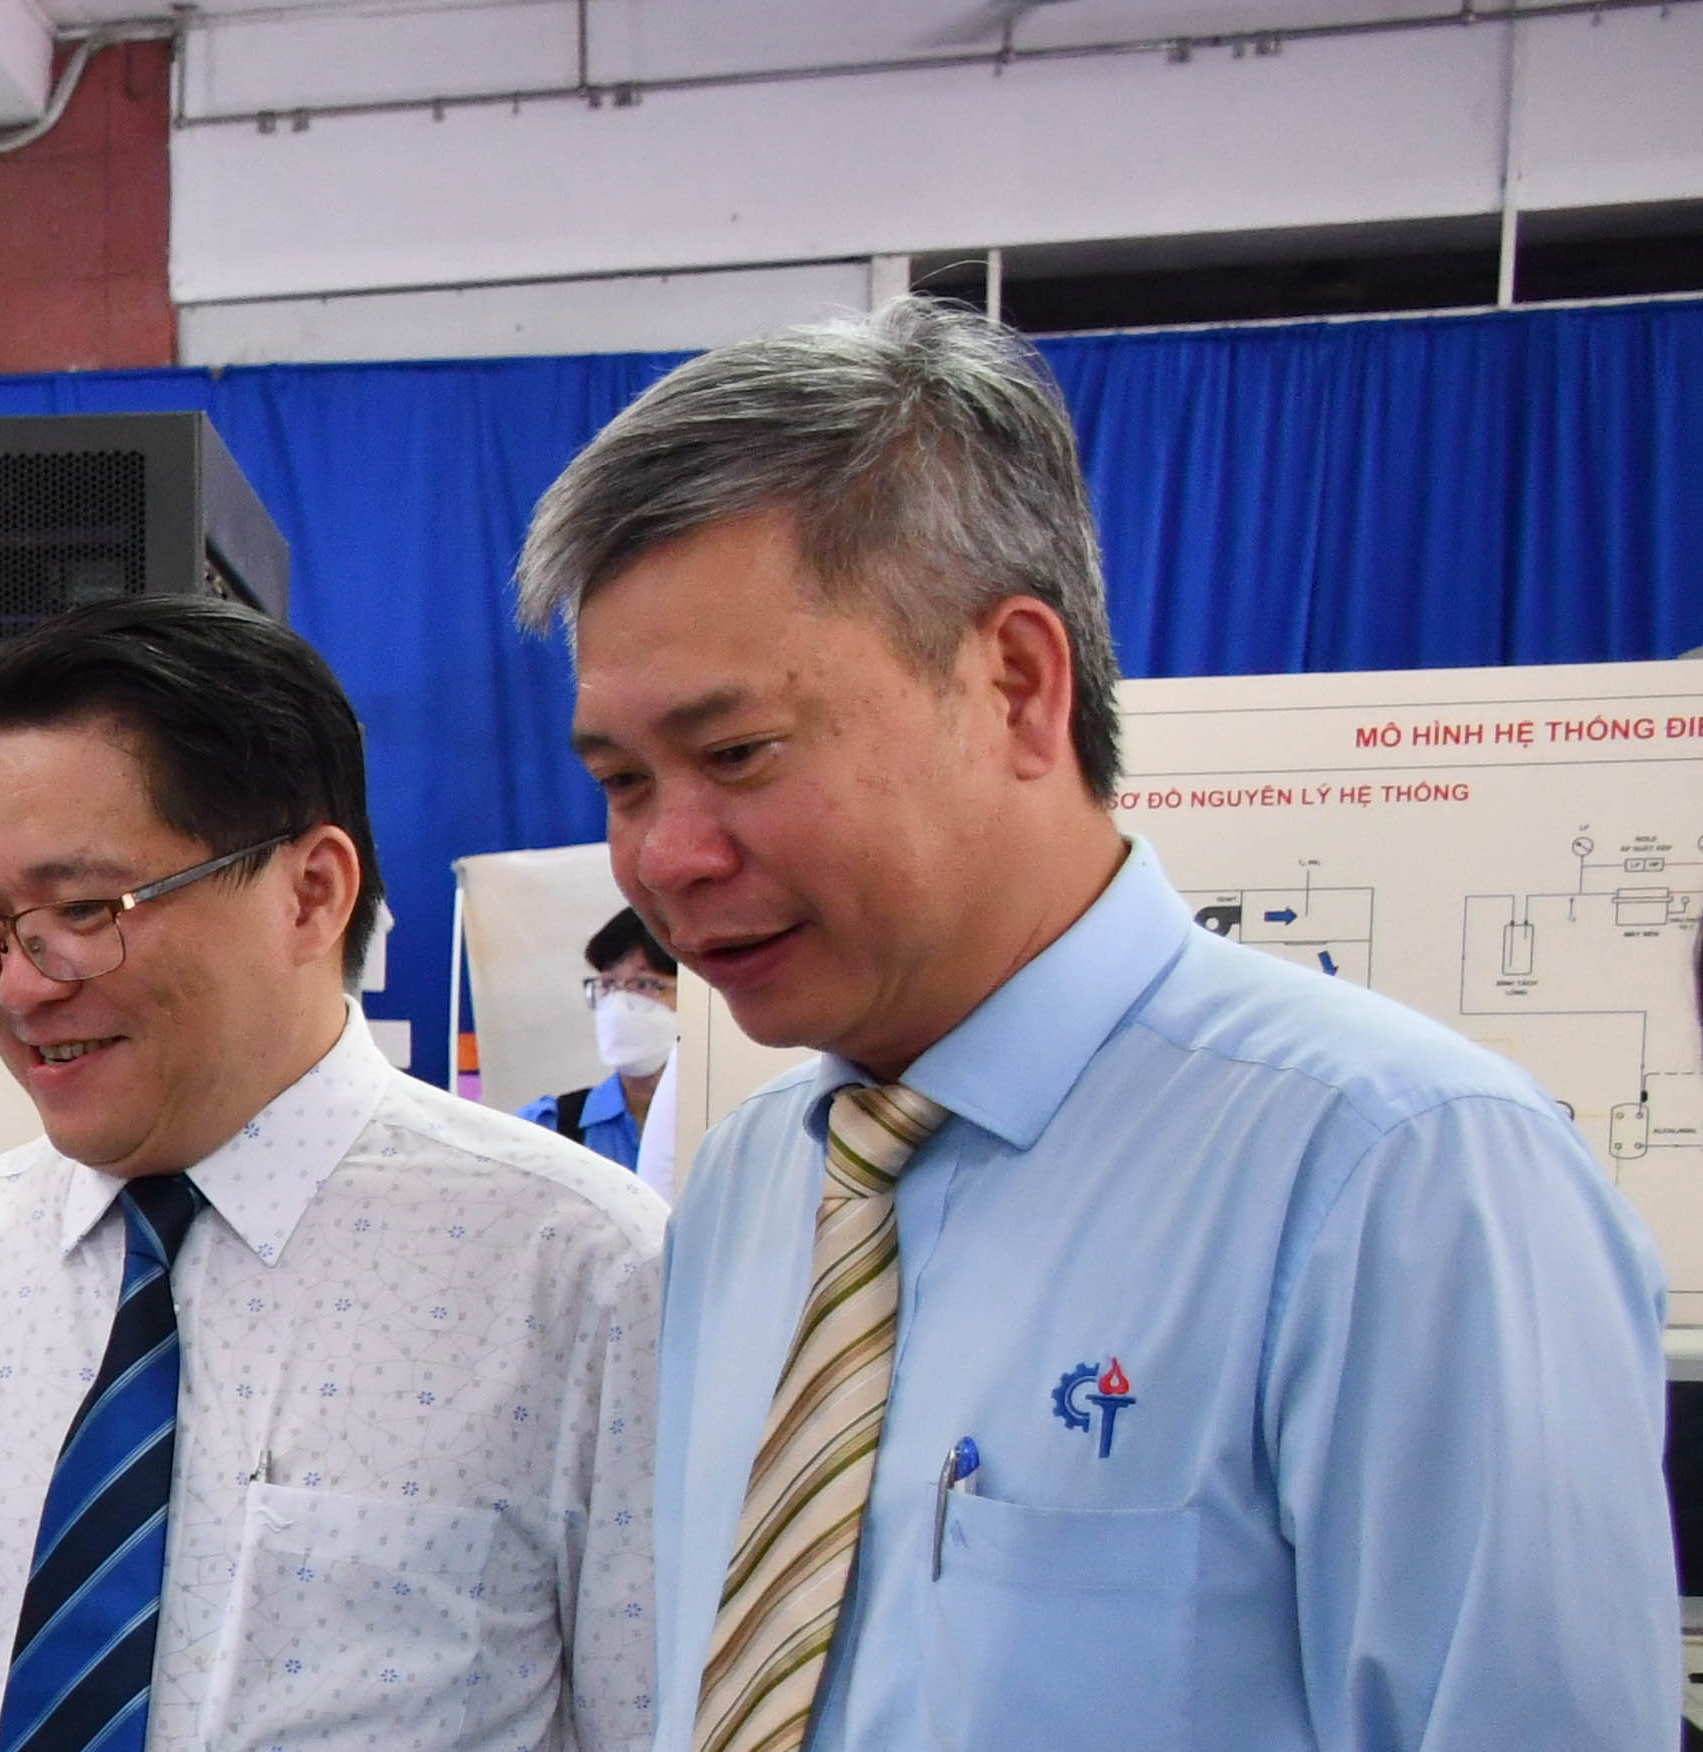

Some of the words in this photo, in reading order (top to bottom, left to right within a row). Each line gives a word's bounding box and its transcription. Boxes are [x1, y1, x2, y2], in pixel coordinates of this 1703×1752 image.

[1355, 722, 1401, 748] MÔ
[1412, 720, 1483, 746] HÌNH
[1190, 784, 1293, 807] NGUYÊN
[1302, 782, 1329, 804] LÝ
